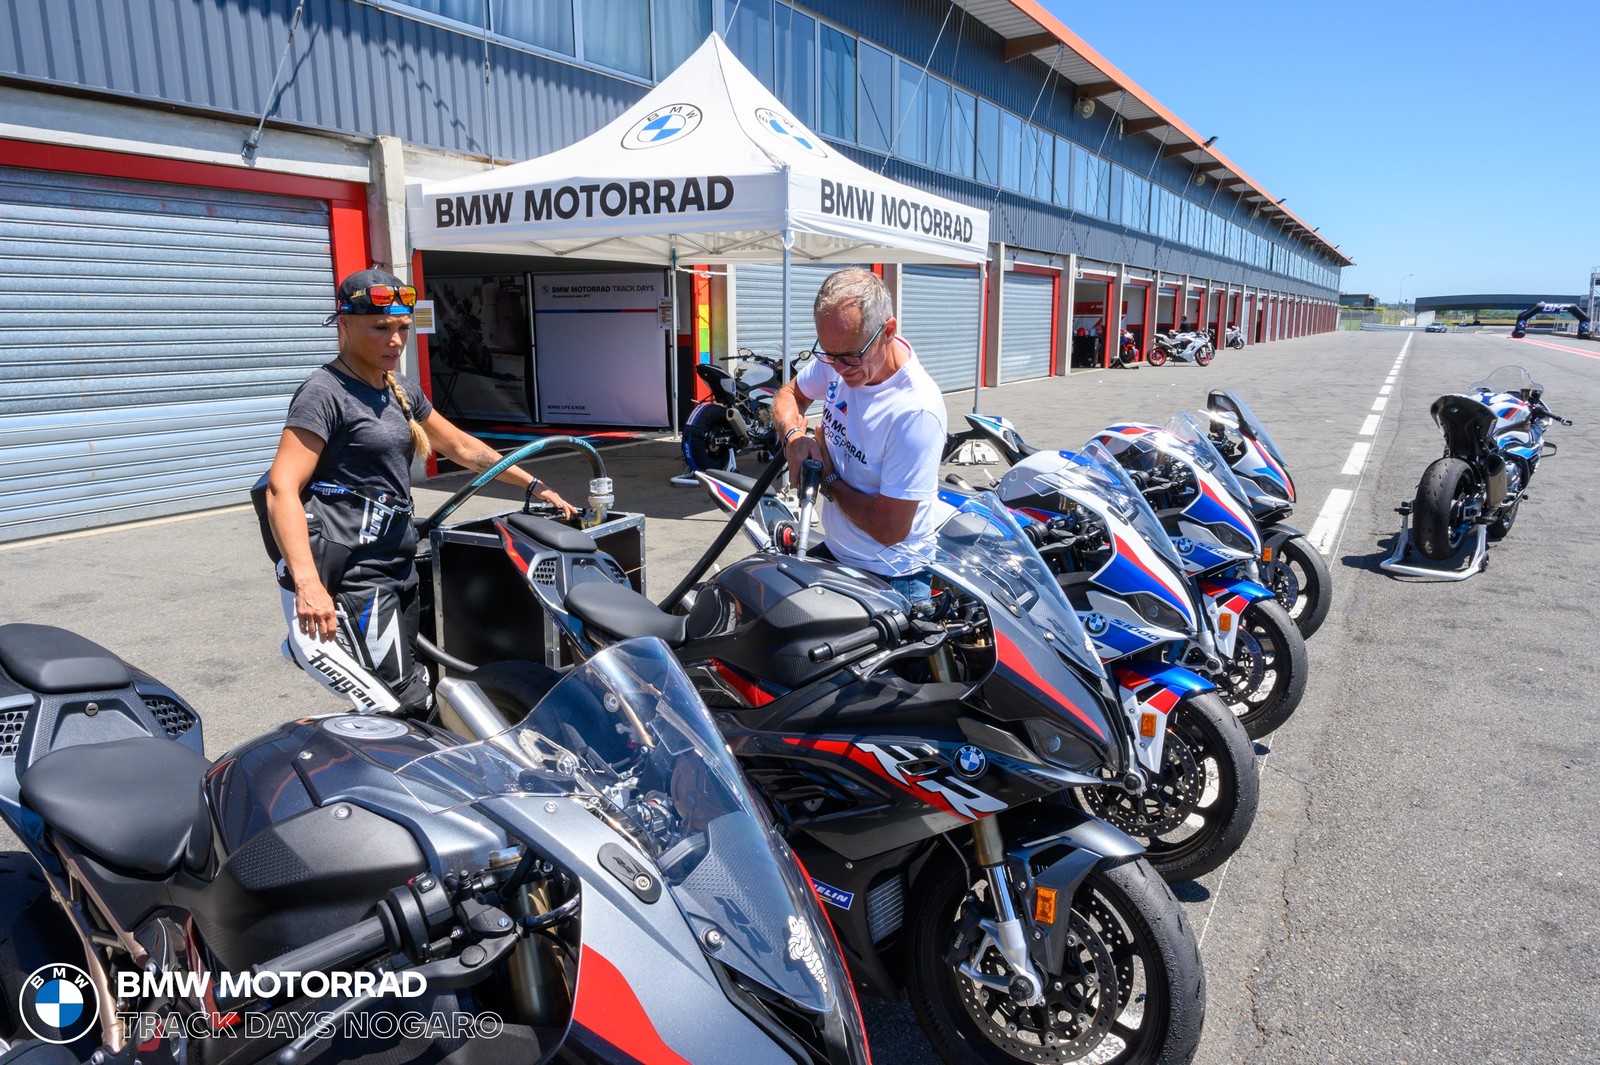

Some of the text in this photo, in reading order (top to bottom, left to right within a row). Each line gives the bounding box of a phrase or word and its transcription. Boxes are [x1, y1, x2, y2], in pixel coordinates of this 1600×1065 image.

[436, 175, 735, 229] BMW MOTORRAD
[820, 178, 875, 223] BMW
[881, 192, 974, 244] MOTORRAD
[571, 285, 611, 293] MOTORRAD
[613, 284, 635, 292] TRACK
[636, 284, 655, 292] DAYS
[480, 455, 520, 484] TRELLEBORG
[1195, 541, 1234, 559] S1000
[1110, 618, 1161, 641] S1000
[991, 756, 1063, 789] S1000
[814, 882, 849, 904] ELIN
[953, 931, 965, 950] BMW
